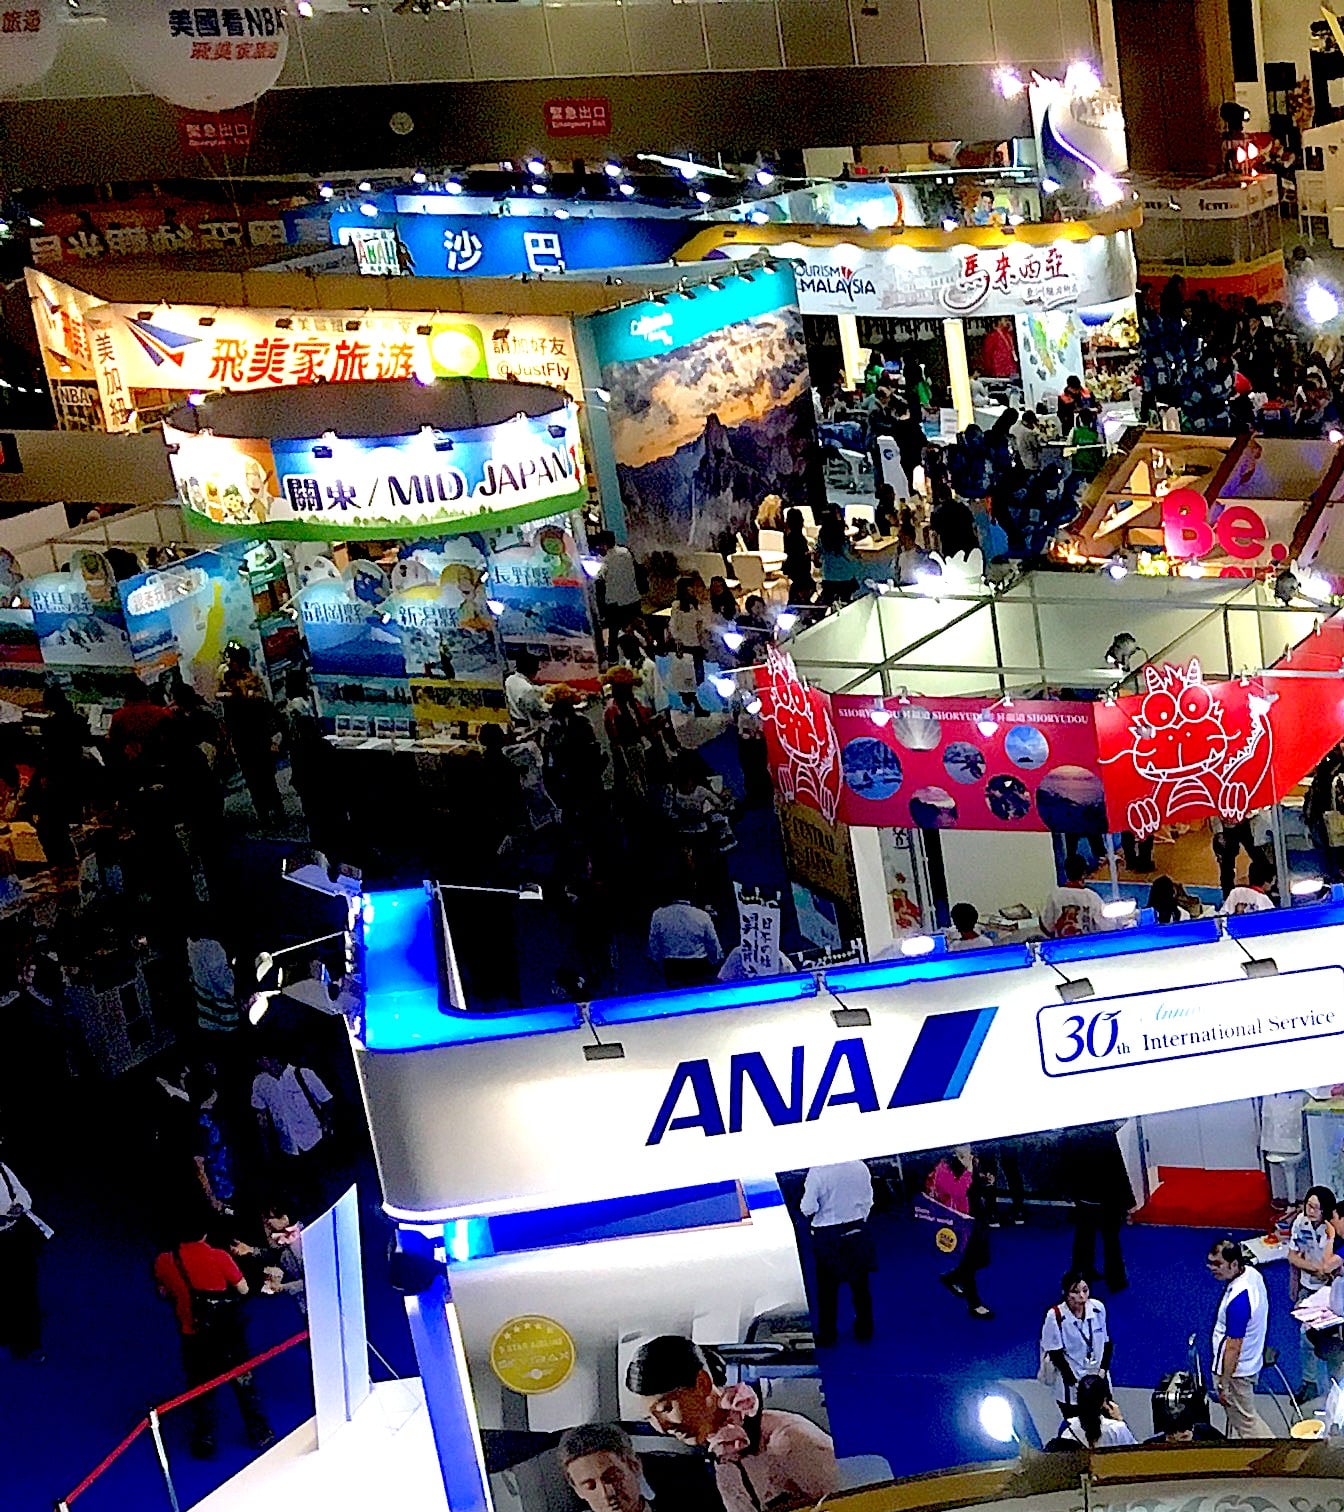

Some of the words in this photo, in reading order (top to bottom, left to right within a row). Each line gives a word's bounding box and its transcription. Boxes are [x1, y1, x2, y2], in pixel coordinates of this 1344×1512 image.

[549, 106, 605, 120] 緊急出口
[444, 230, 566, 273] 沙巴
[800, 278, 876, 301] MALAYSIA
[286, 477, 363, 511] 關東
[387, 471, 465, 507] MID
[478, 447, 571, 497] JAPAN
[1142, 1016, 1263, 1052] International
[1269, 1007, 1337, 1035] Service
[645, 1036, 881, 1147] ANA
